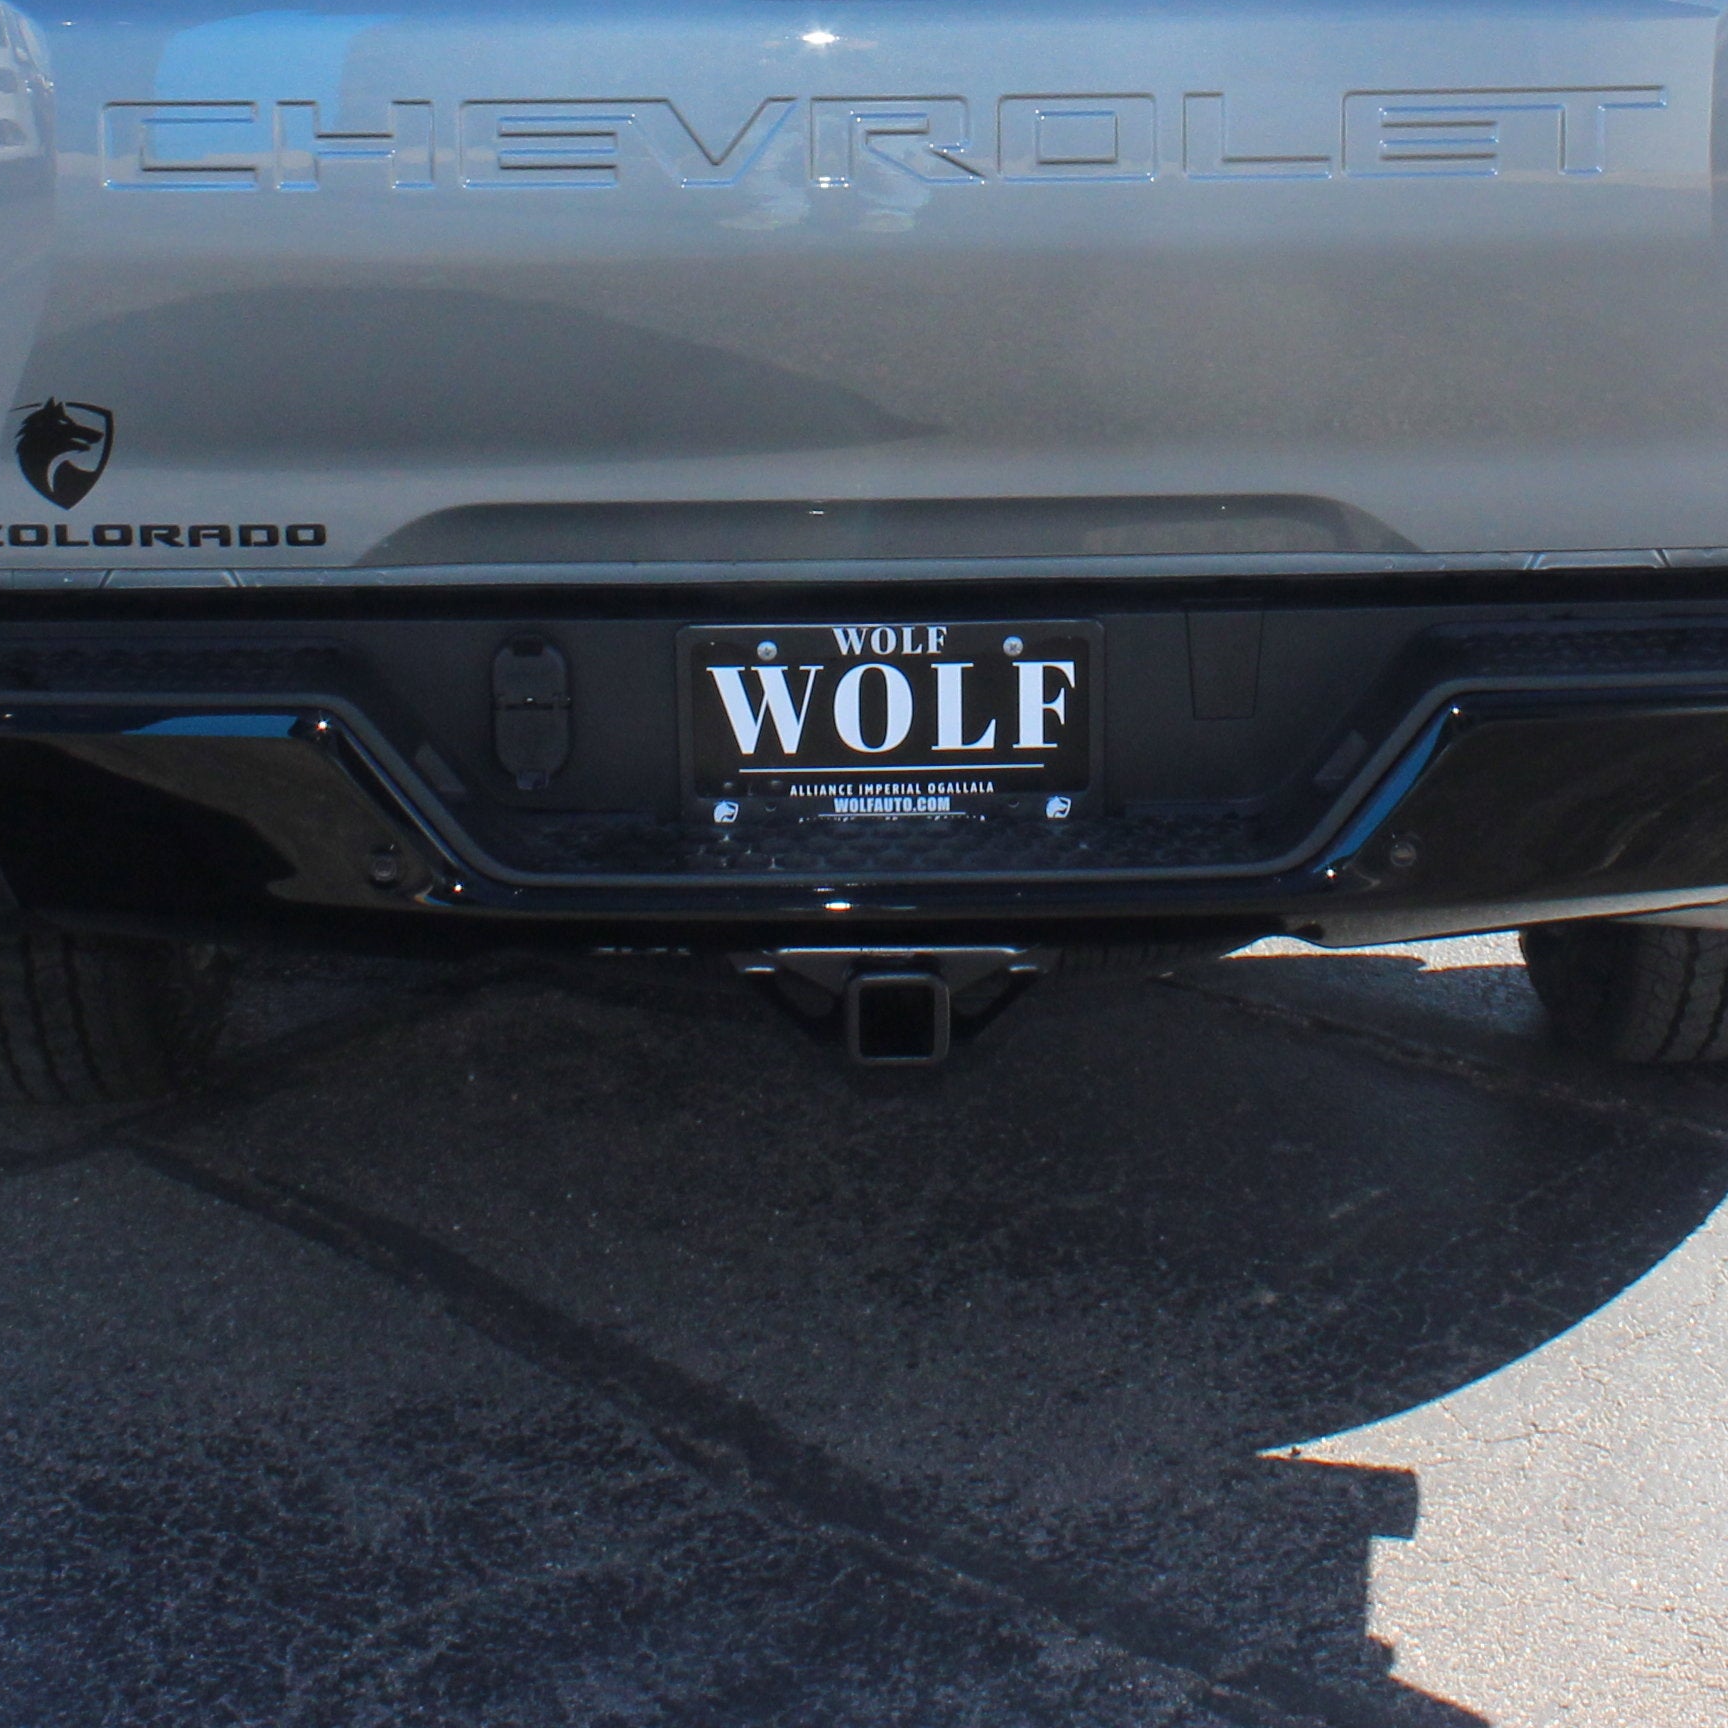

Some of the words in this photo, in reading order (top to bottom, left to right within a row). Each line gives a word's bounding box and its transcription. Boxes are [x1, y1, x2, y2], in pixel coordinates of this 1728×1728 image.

[100, 84, 1668, 191] CHEVROLET
[832, 625, 948, 656] WOLF
[706, 660, 1076, 755] WOLF
[790, 784, 853, 796] ALLIANCE
[859, 783, 922, 795] IMPERIAL
[928, 781, 994, 794] OGALLALA
[833, 796, 951, 813] WOLFAUTO.COM
